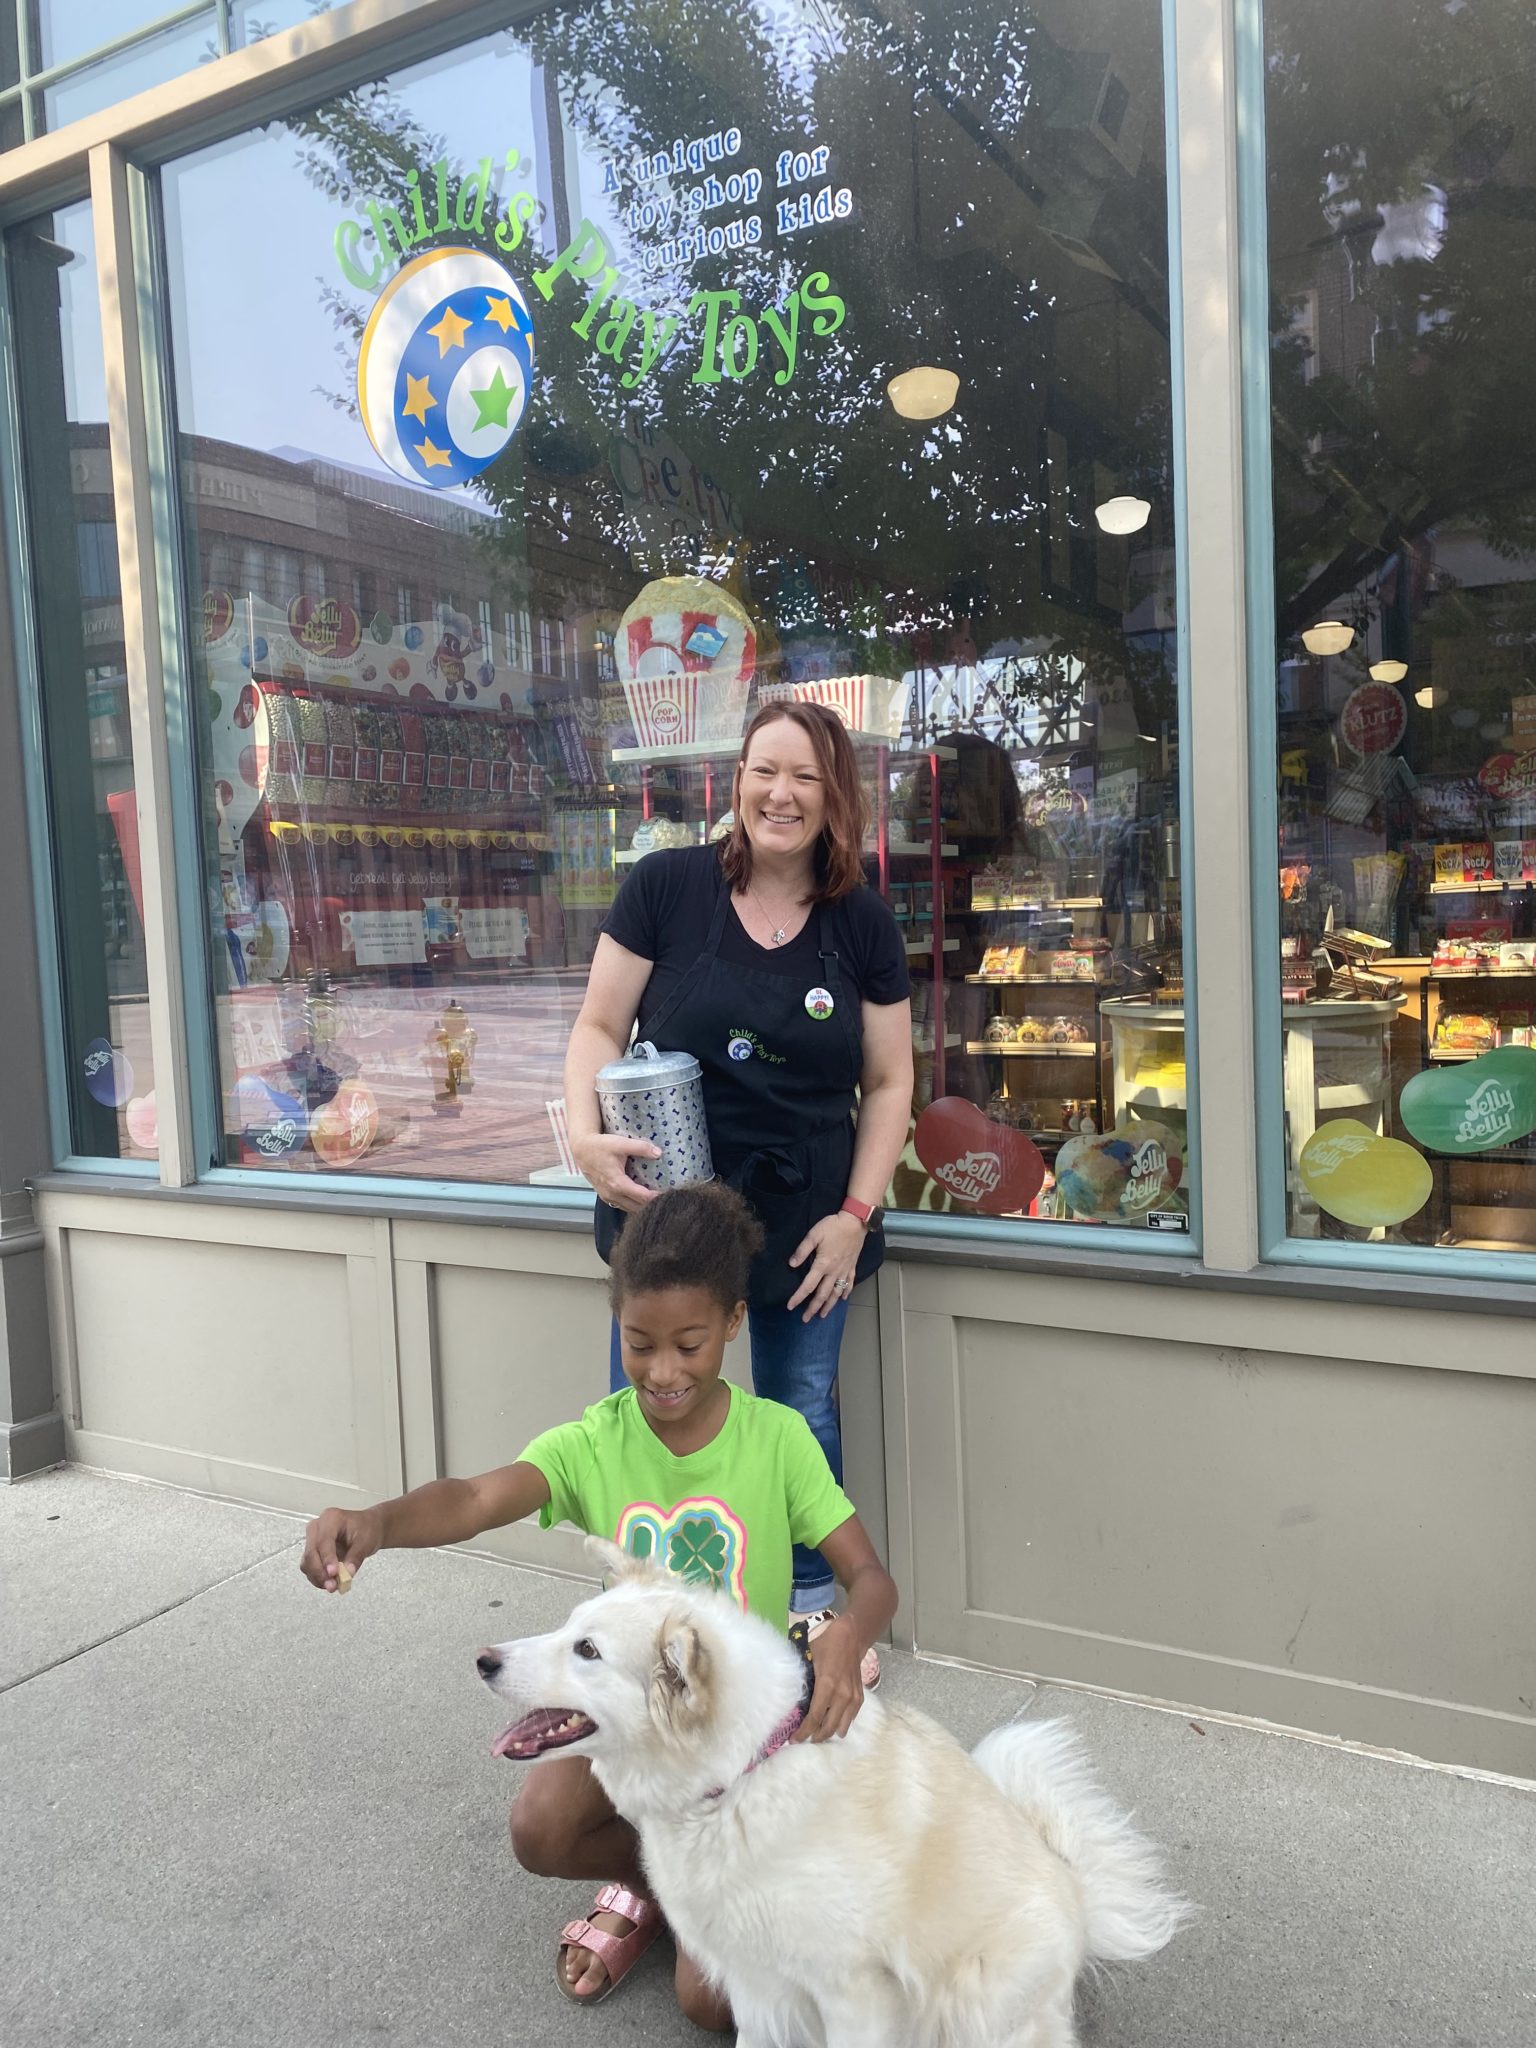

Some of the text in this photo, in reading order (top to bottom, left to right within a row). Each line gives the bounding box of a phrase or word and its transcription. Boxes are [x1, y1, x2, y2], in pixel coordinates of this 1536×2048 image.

[600, 126, 743, 195] A unique
[627, 144, 831, 233] toy shop for
[641, 187, 854, 273] curious kids
[334, 148, 847, 389] Child's Play Toys
[311, 598, 342, 629] Jelly
[302, 622, 338, 650] Belly
[654, 715, 681, 725] CORN
[657, 707, 674, 717] POP
[1350, 706, 1399, 732] KLUTZ
[1510, 750, 1536, 776] Jell
[1498, 773, 1536, 796] Bell
[1465, 857, 1490, 869] POCKY
[729, 1028, 787, 1065] Child's Play Toys
[1464, 1078, 1515, 1121] Jelly
[271, 1119, 296, 1148] Jelly
[1455, 1113, 1512, 1144] Belly
[256, 1133, 286, 1157] Belly
[1131, 1138, 1168, 1177] Jelly
[1304, 1141, 1345, 1177] Belly
[1328, 1135, 1375, 1158] Jelly
[936, 1162, 986, 1203] Belly
[957, 1150, 1000, 1193] Jelly
[1120, 1174, 1163, 1210] Belly
